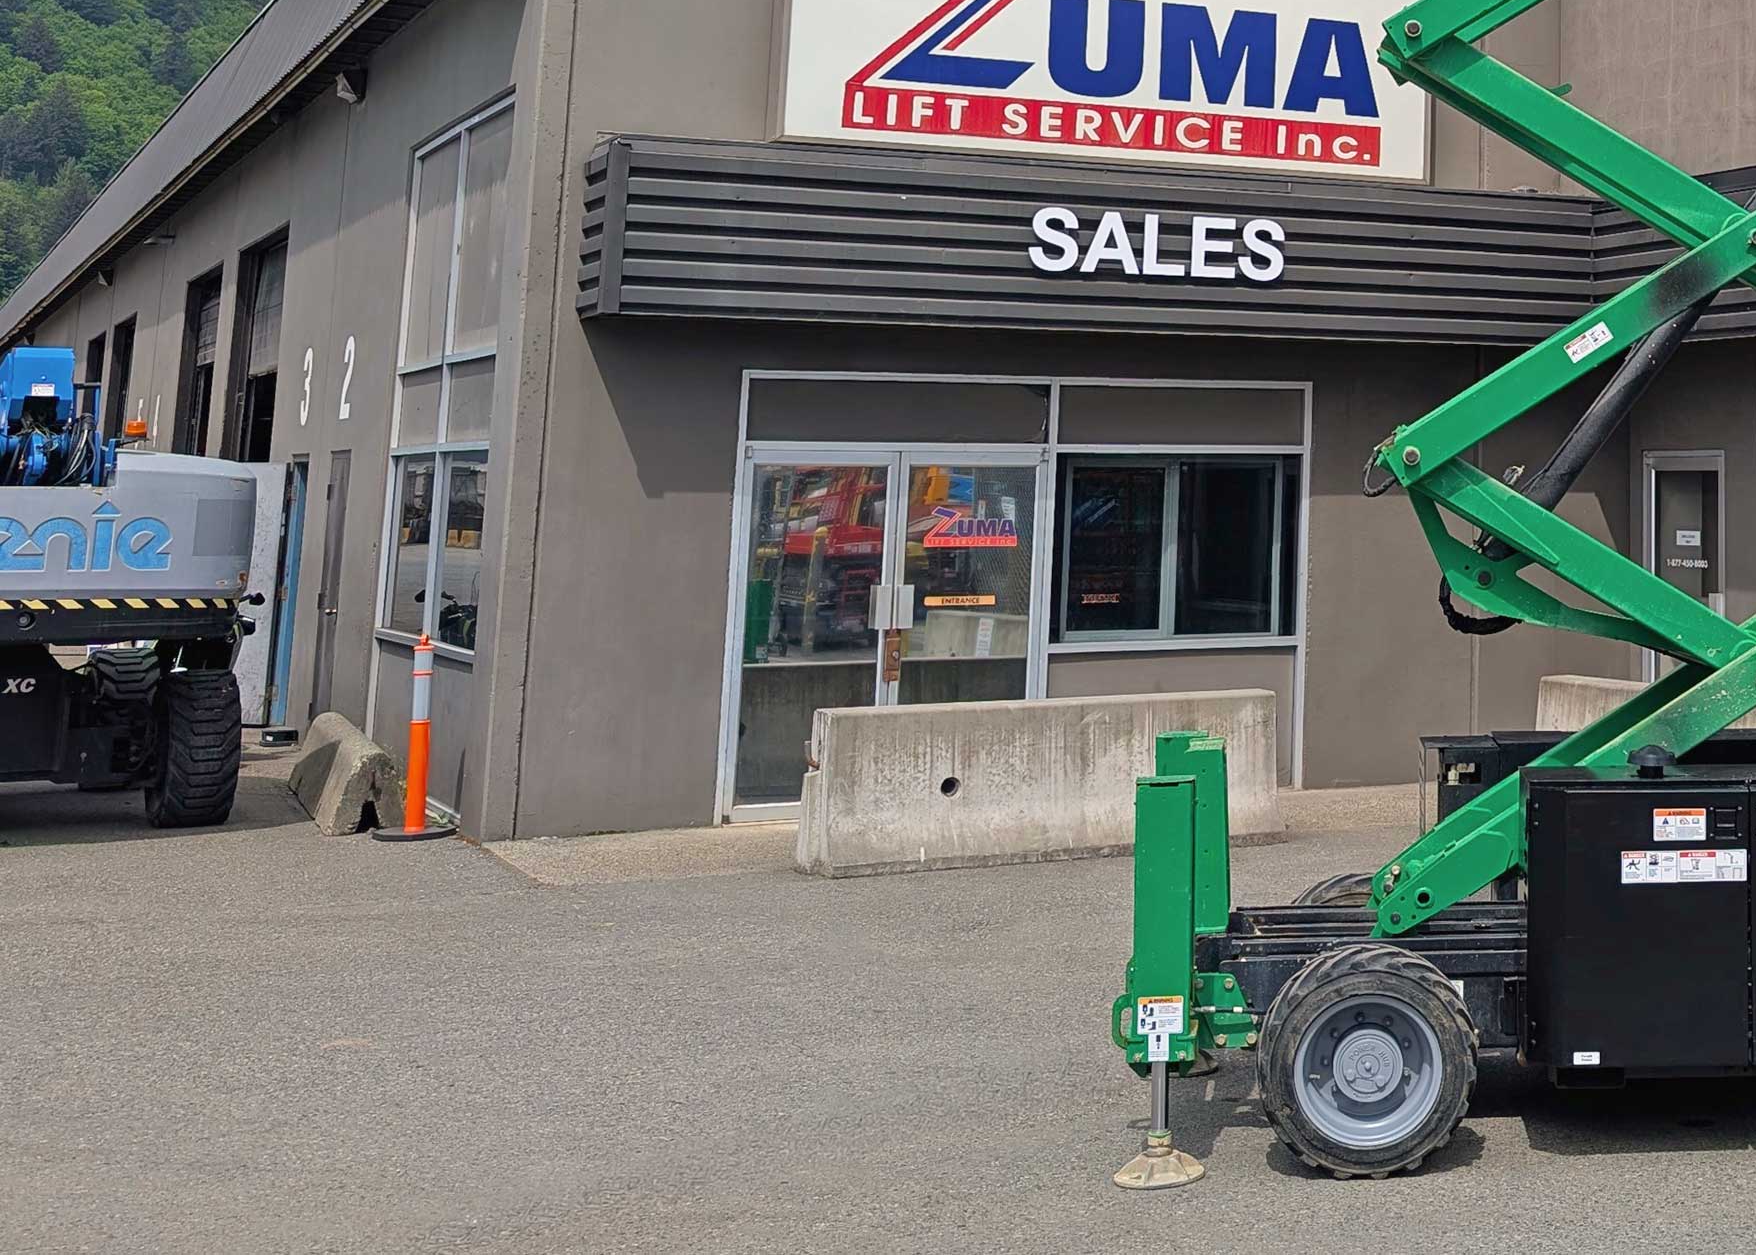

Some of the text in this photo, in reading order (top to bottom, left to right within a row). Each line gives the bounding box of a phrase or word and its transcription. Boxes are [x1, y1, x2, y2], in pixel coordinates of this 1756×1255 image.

[852, 88, 1372, 161] LIFT SERVICE Inc.
[1028, 205, 1286, 283] SALES
[299, 347, 314, 426] 3
[338, 335, 356, 421] 2
[0, 500, 174, 572] enie
[926, 506, 1016, 538] ZUMA
[941, 596, 980, 605] ENTRANCE
[2, 678, 36, 694] XC
